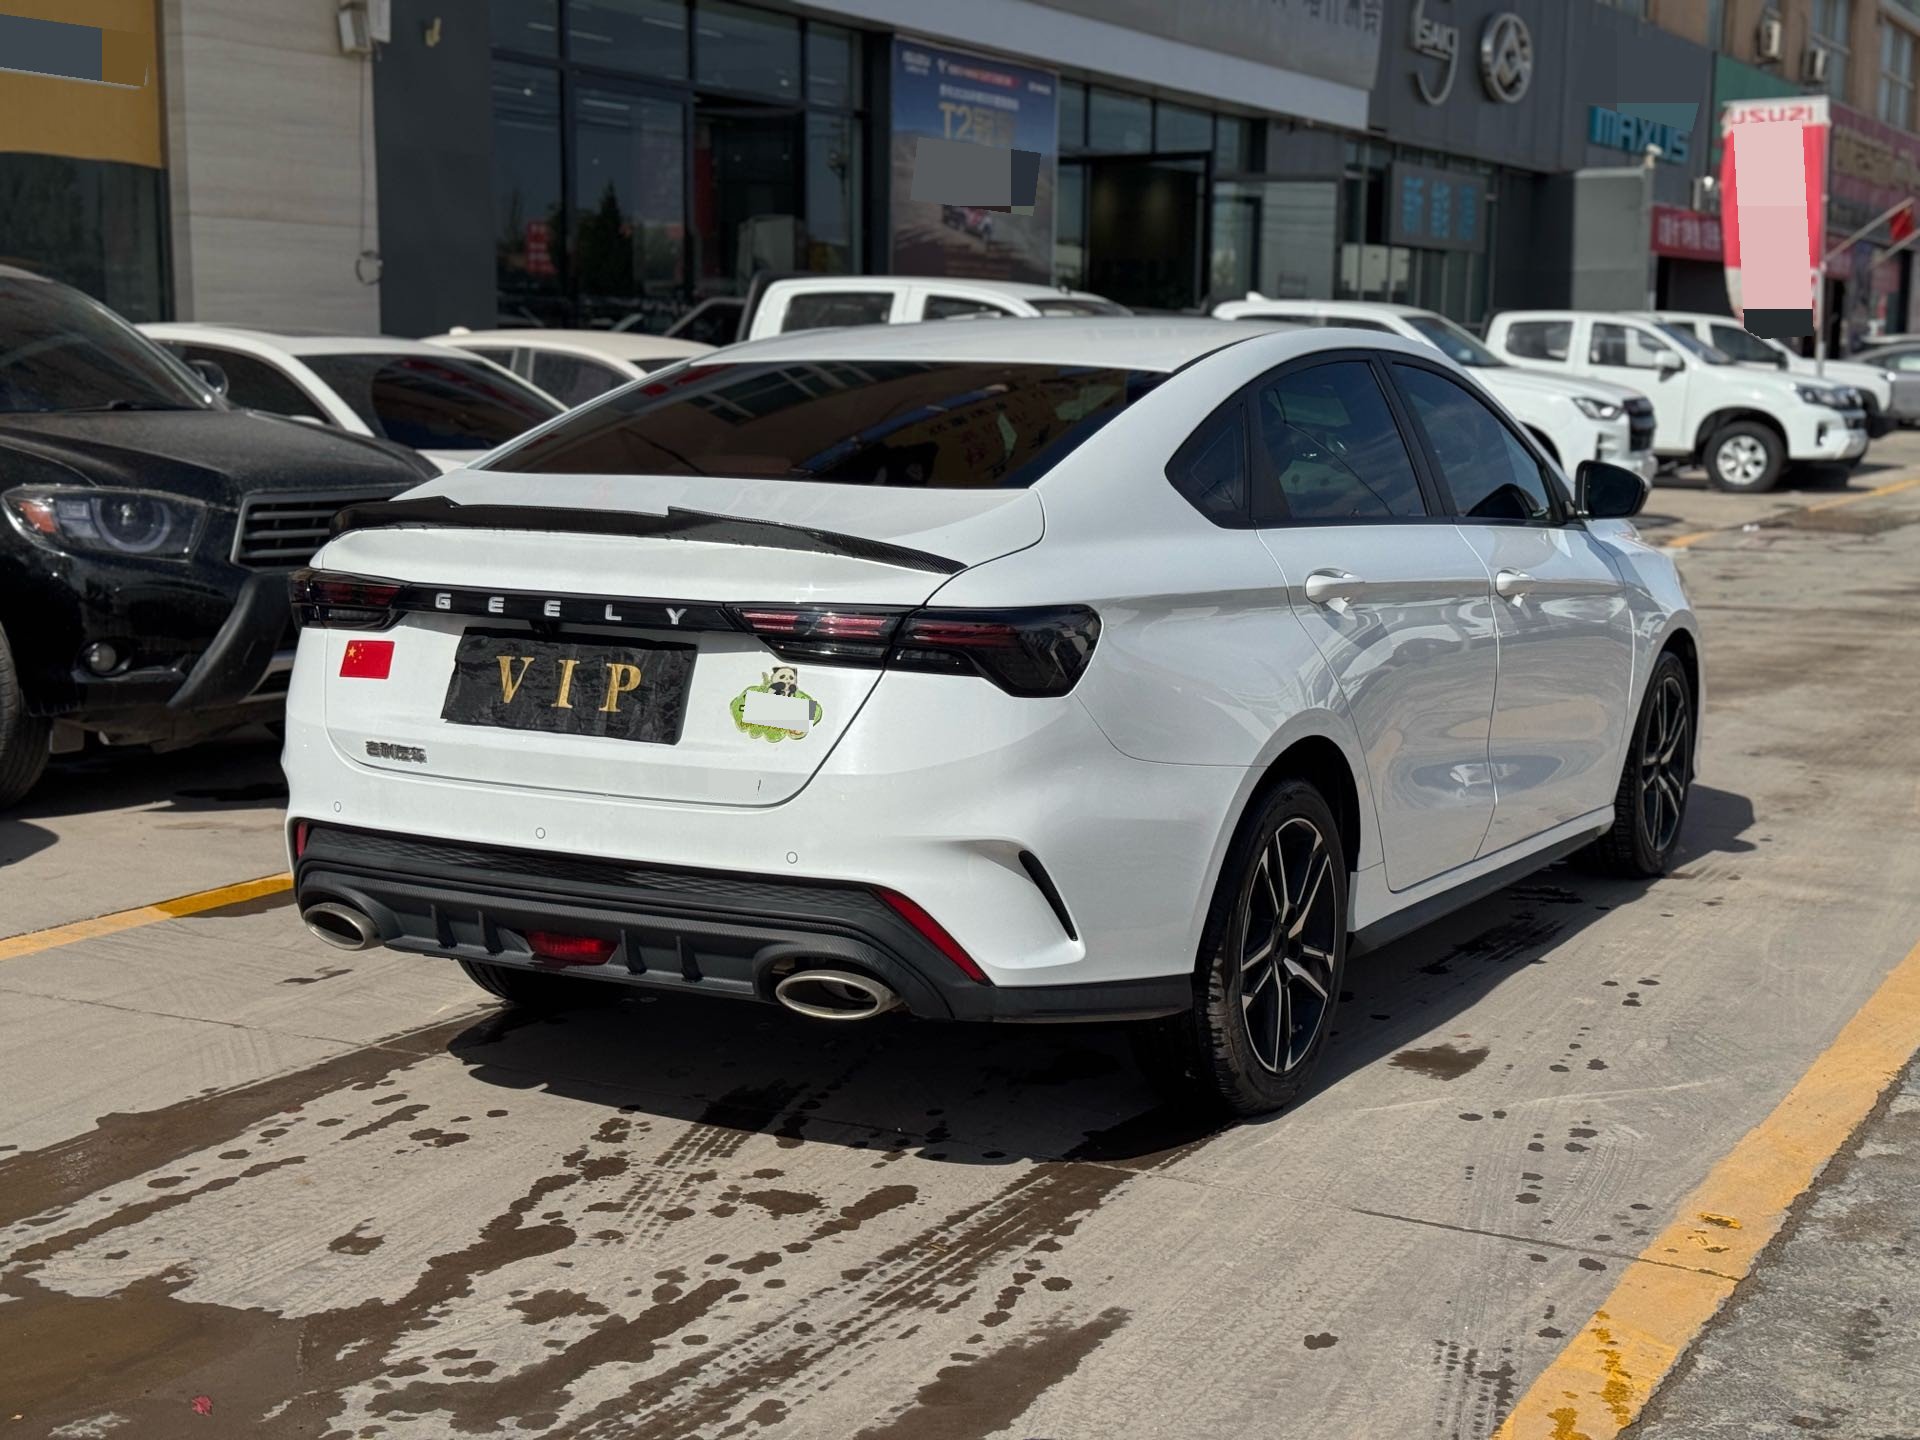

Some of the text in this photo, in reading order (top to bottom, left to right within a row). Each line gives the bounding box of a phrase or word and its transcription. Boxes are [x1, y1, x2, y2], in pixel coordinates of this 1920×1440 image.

[1590, 106, 1690, 164] MAXUS
[434, 592, 688, 625] GEELY
[496, 655, 642, 713] VIP
[365, 740, 428, 764] 吉利汽车
